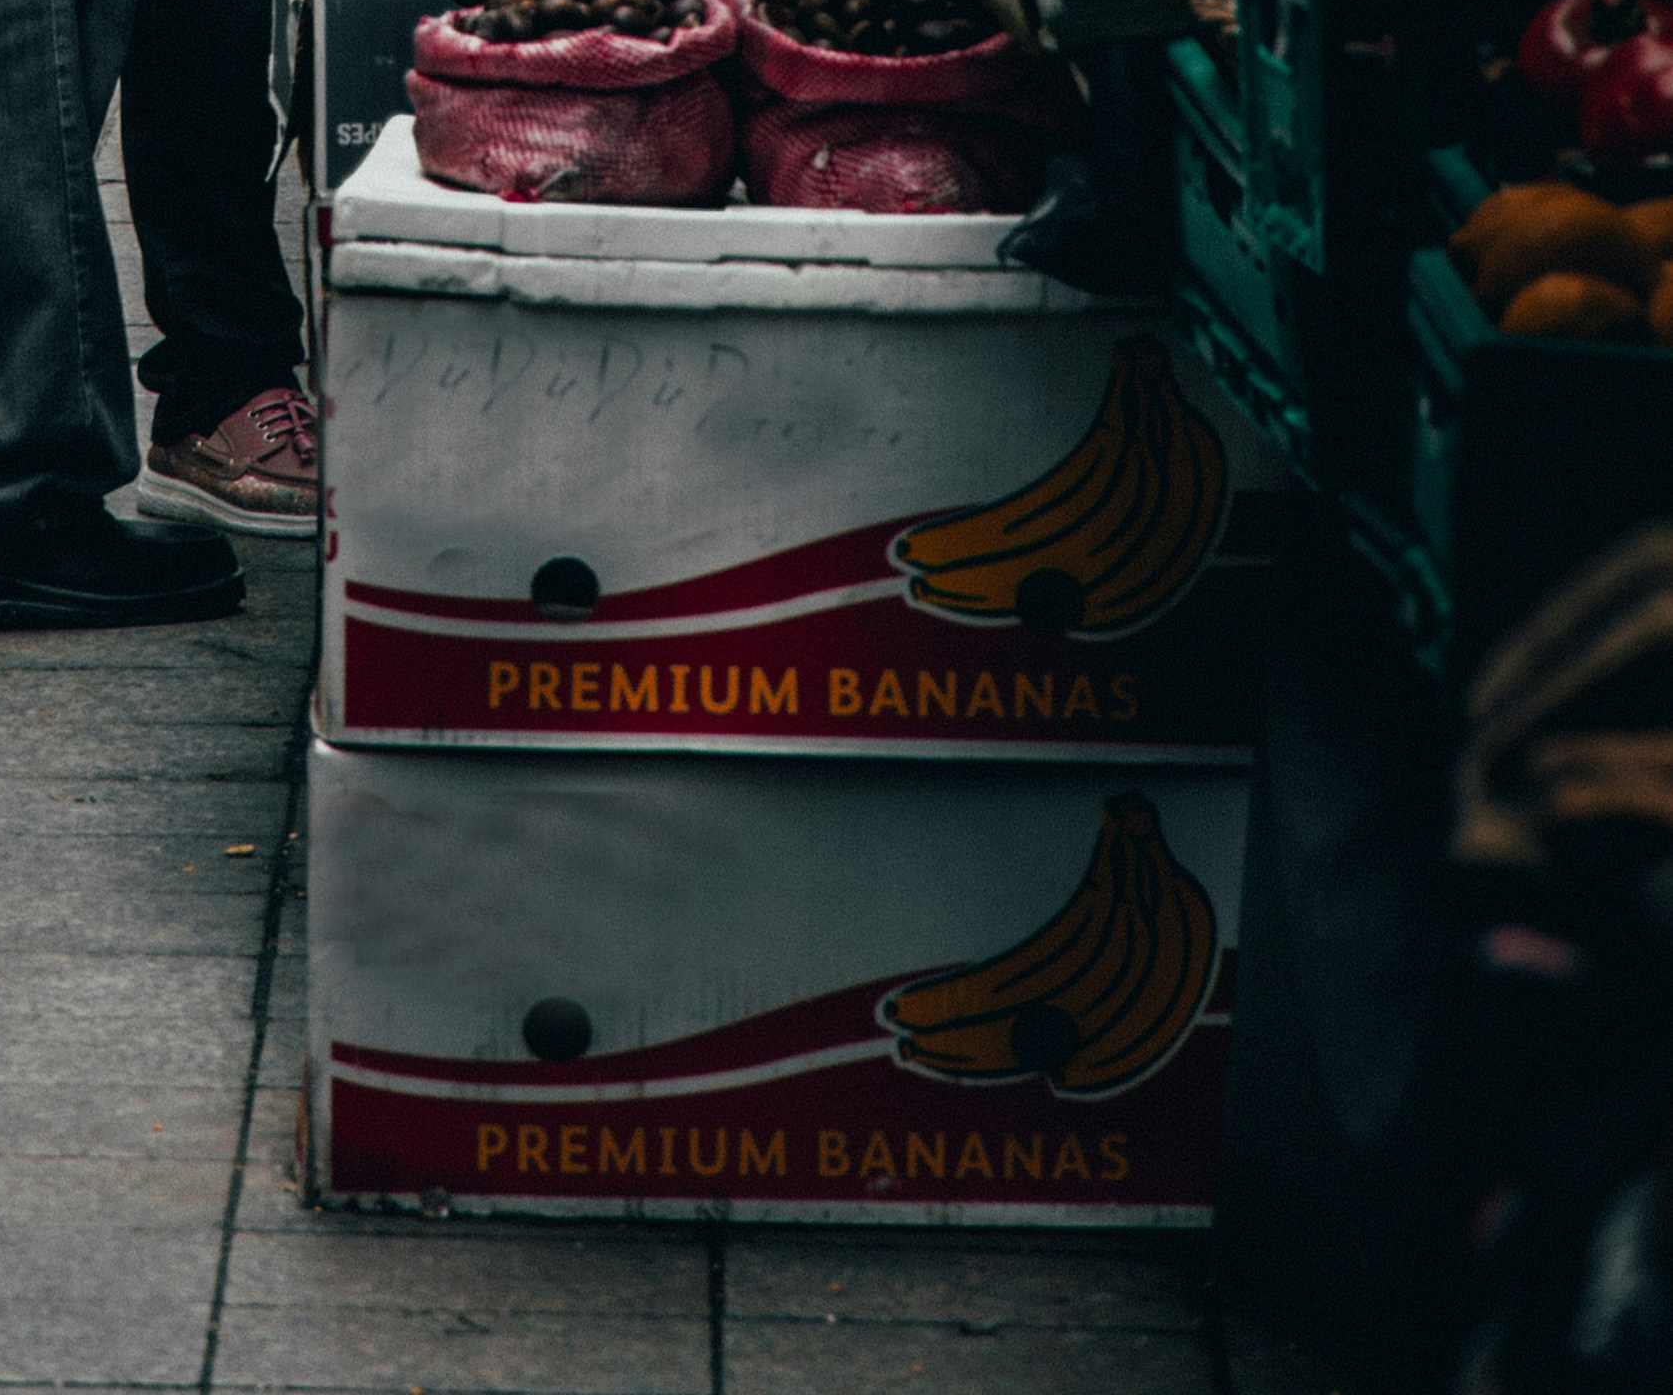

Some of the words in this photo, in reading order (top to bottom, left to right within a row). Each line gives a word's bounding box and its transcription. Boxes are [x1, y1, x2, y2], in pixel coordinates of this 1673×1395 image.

[488, 660, 800, 716] PREMIUM
[828, 667, 1140, 722] BANANAS
[477, 1123, 787, 1177] PREMIUM
[817, 1129, 1128, 1181] BANANAS
